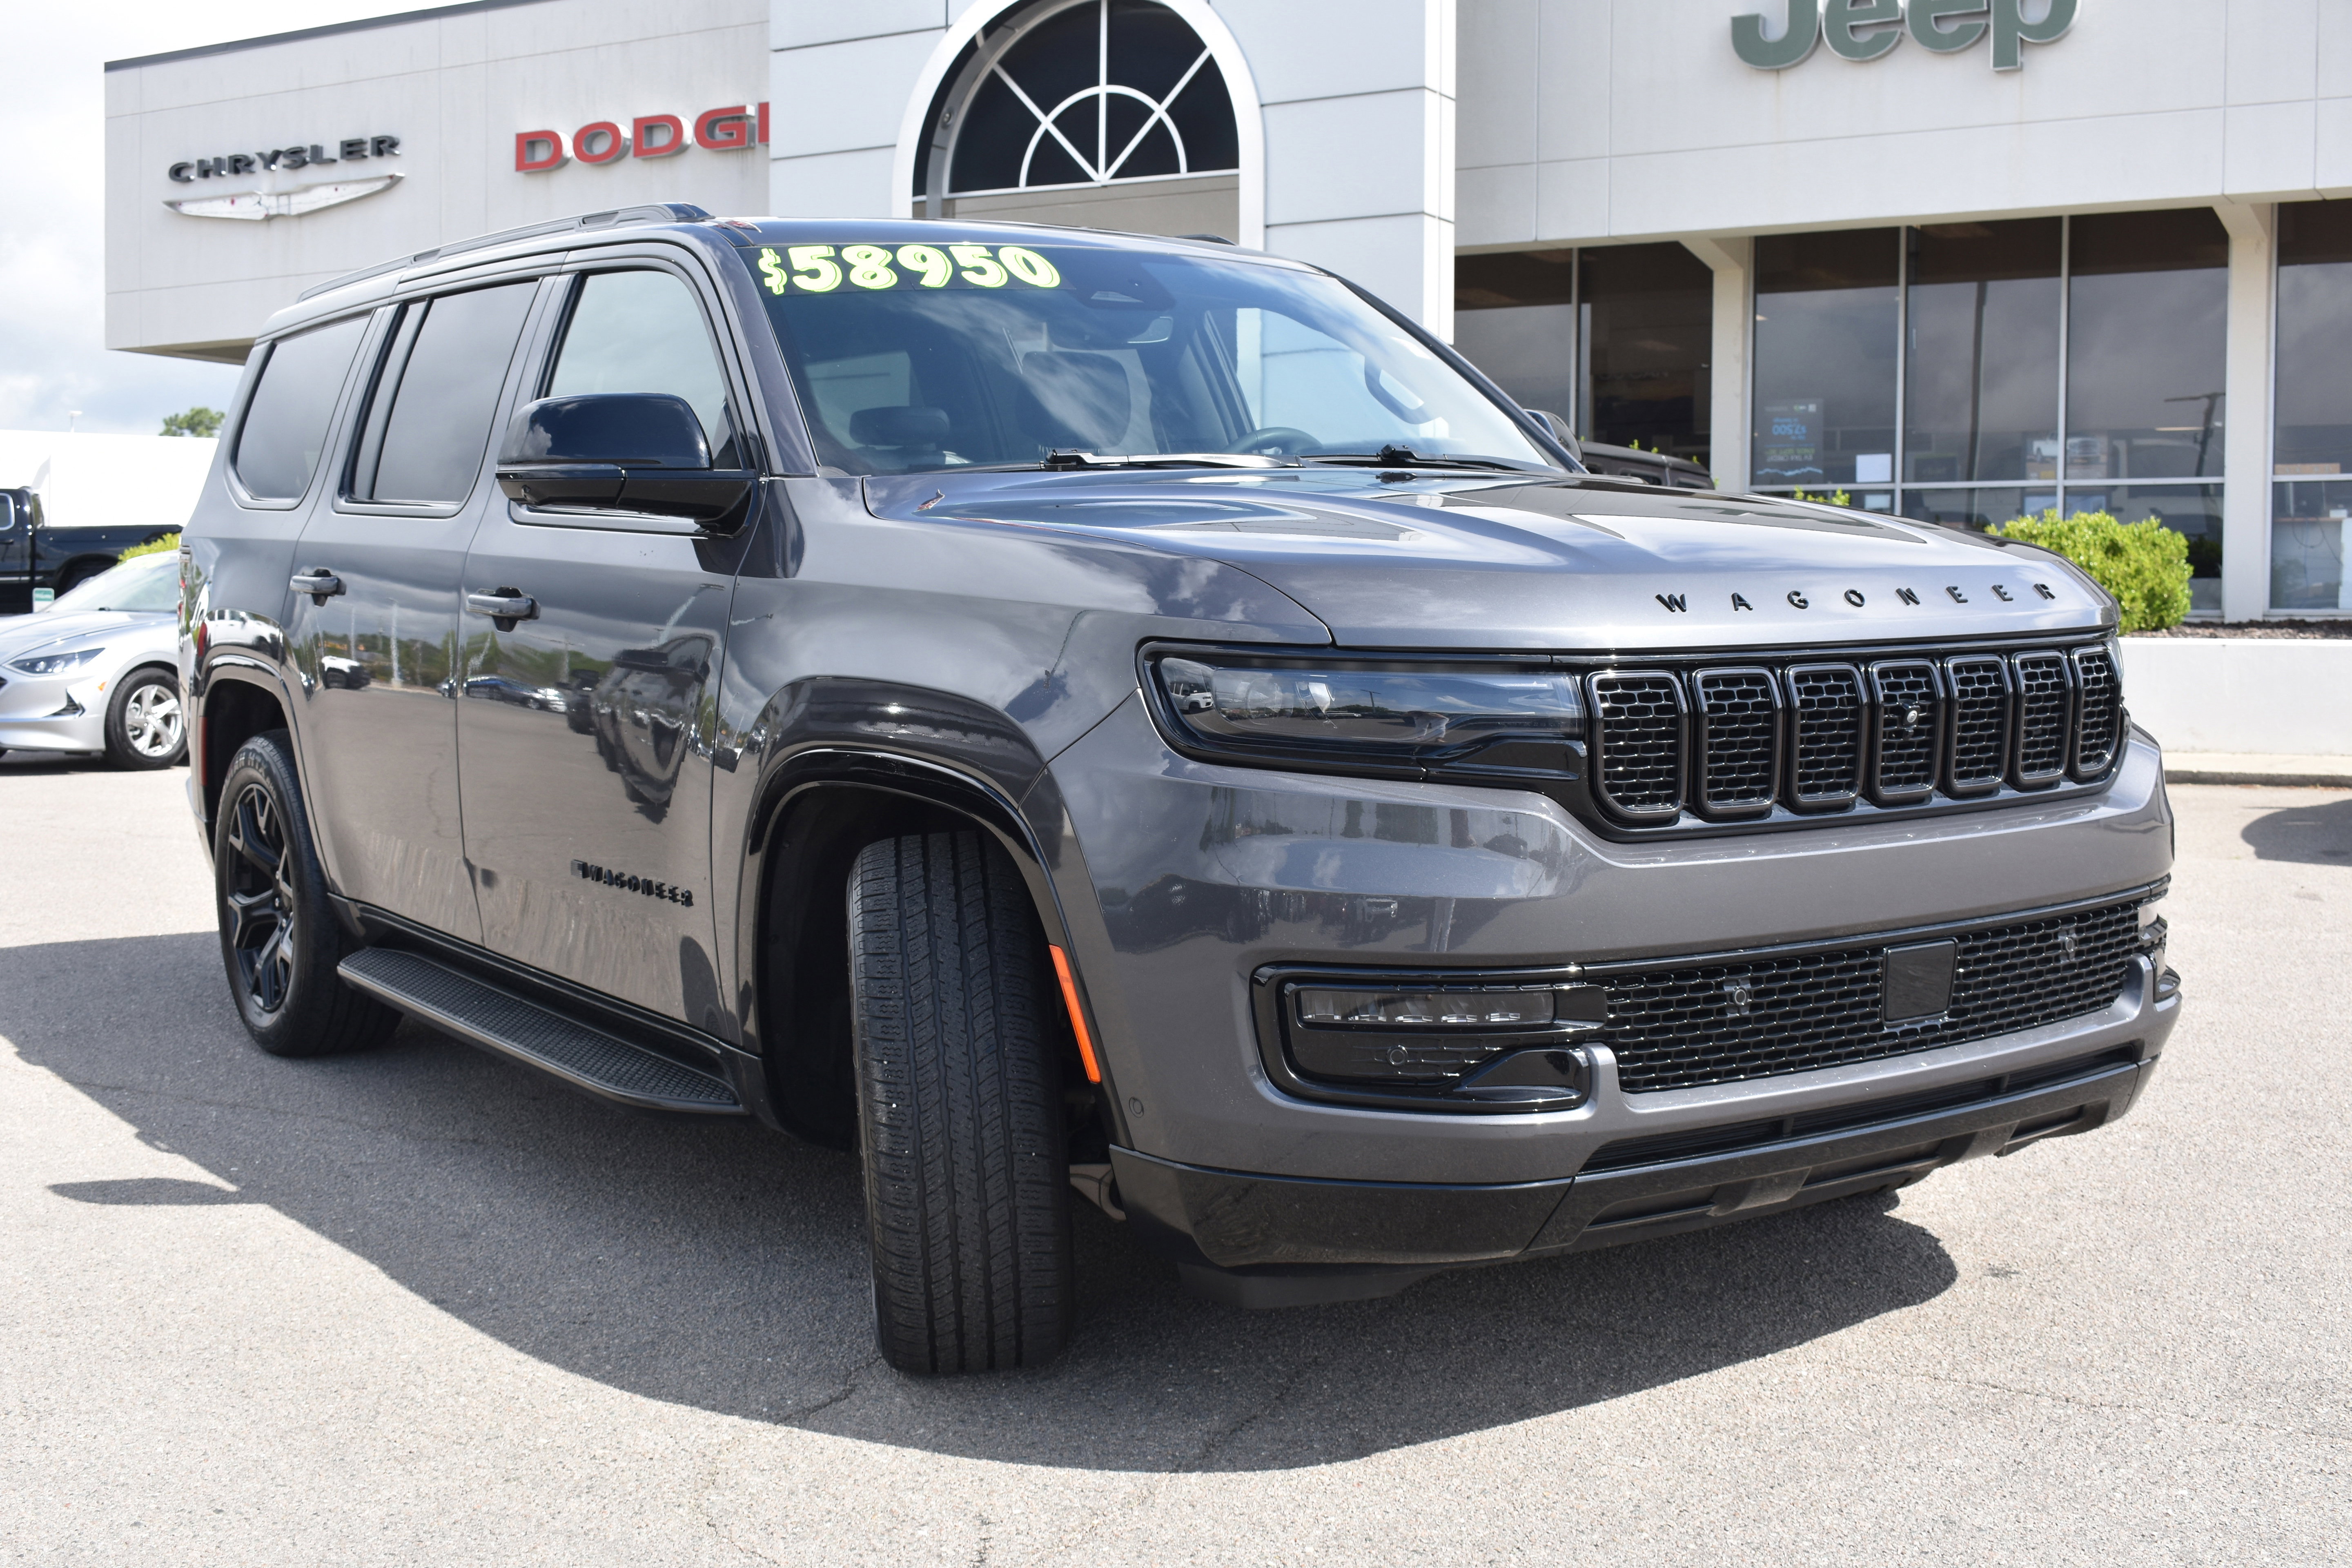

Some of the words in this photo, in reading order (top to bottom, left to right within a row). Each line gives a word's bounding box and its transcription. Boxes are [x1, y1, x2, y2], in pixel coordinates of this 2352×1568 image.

[1731, 0, 2079, 71] Jeep
[169, 134, 401, 183] CHRYSLER
[758, 244, 1061, 295] $58950
[1655, 581, 2056, 613] WAGONEER
[589, 864, 694, 907] WAGONEER
